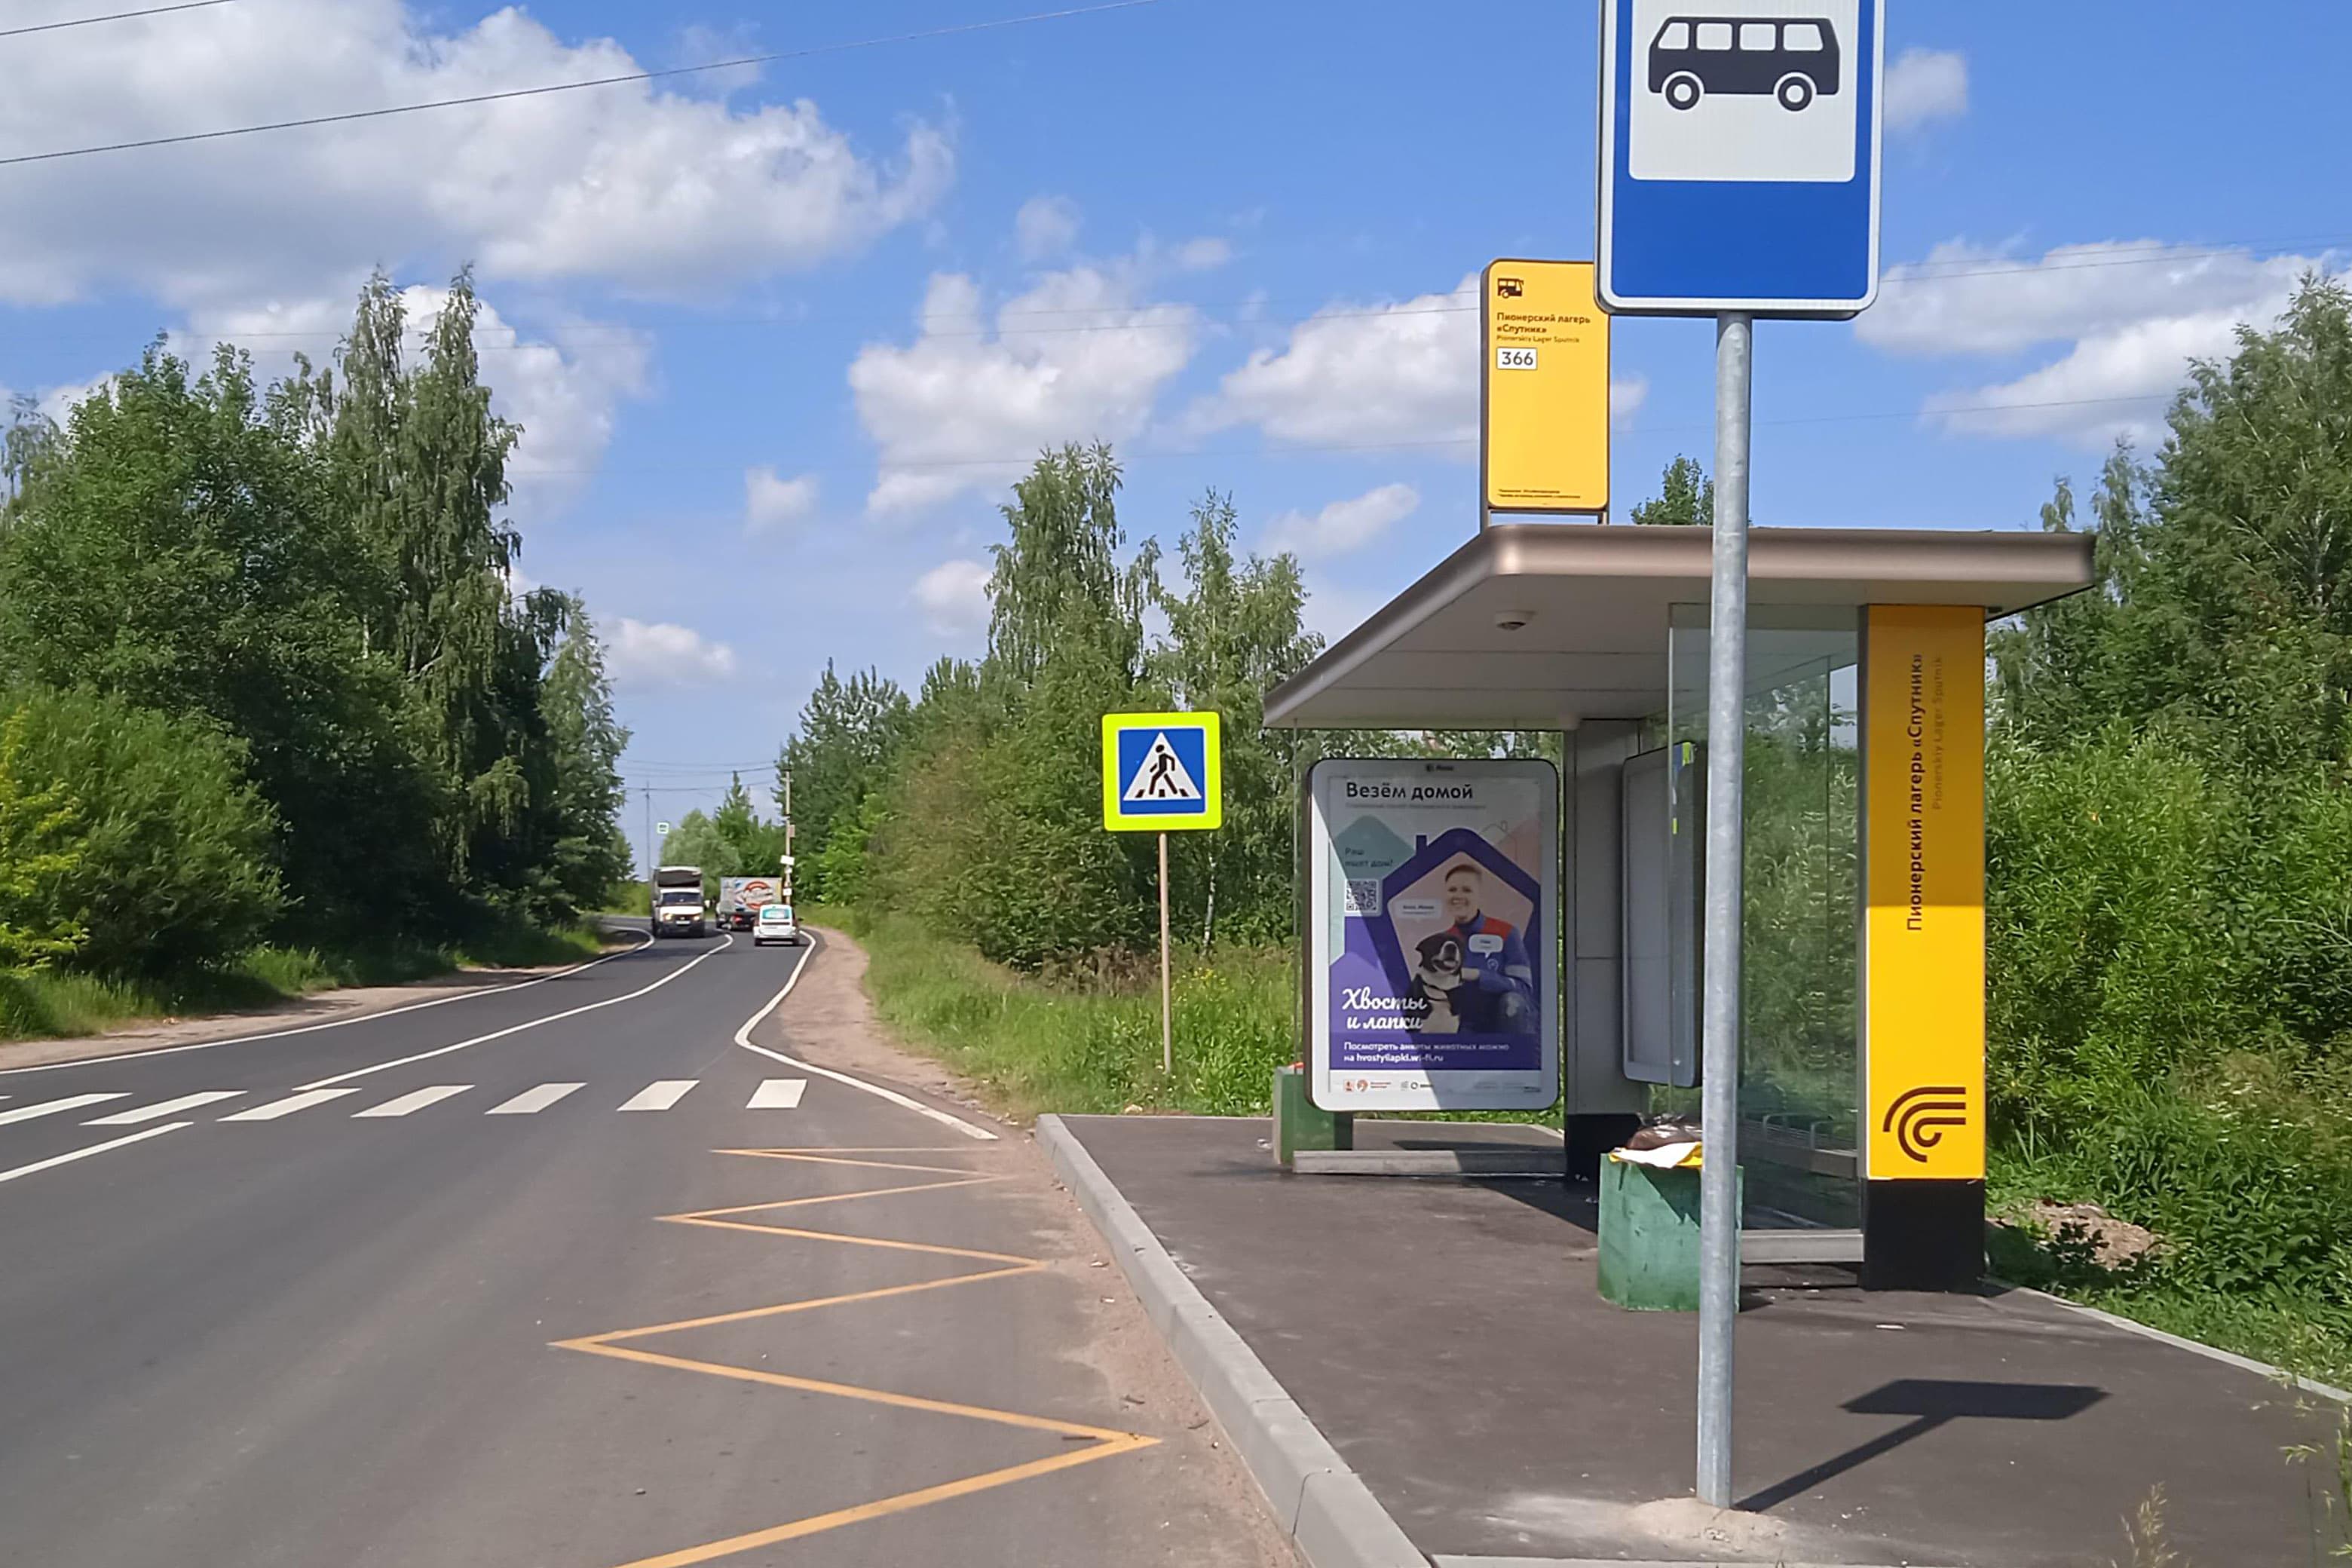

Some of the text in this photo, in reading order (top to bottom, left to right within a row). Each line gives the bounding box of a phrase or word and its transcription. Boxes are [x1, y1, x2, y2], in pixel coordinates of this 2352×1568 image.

[1496, 312, 1591, 325] Пионерский лагерь
[1496, 323, 1547, 334] «Спутник»
[1502, 351, 1533, 366] 366
[1932, 657, 1945, 810] Pionerskiy Lager Sputnik
[1346, 782, 1473, 801] Везём домой
[1907, 654, 1926, 930] Пионерский лагерь «Спутник»
[1342, 986, 1428, 1010] Хвосты
[1346, 1016, 1423, 1030] и лапки
[1344, 1042, 1398, 1052] Посмотреть
